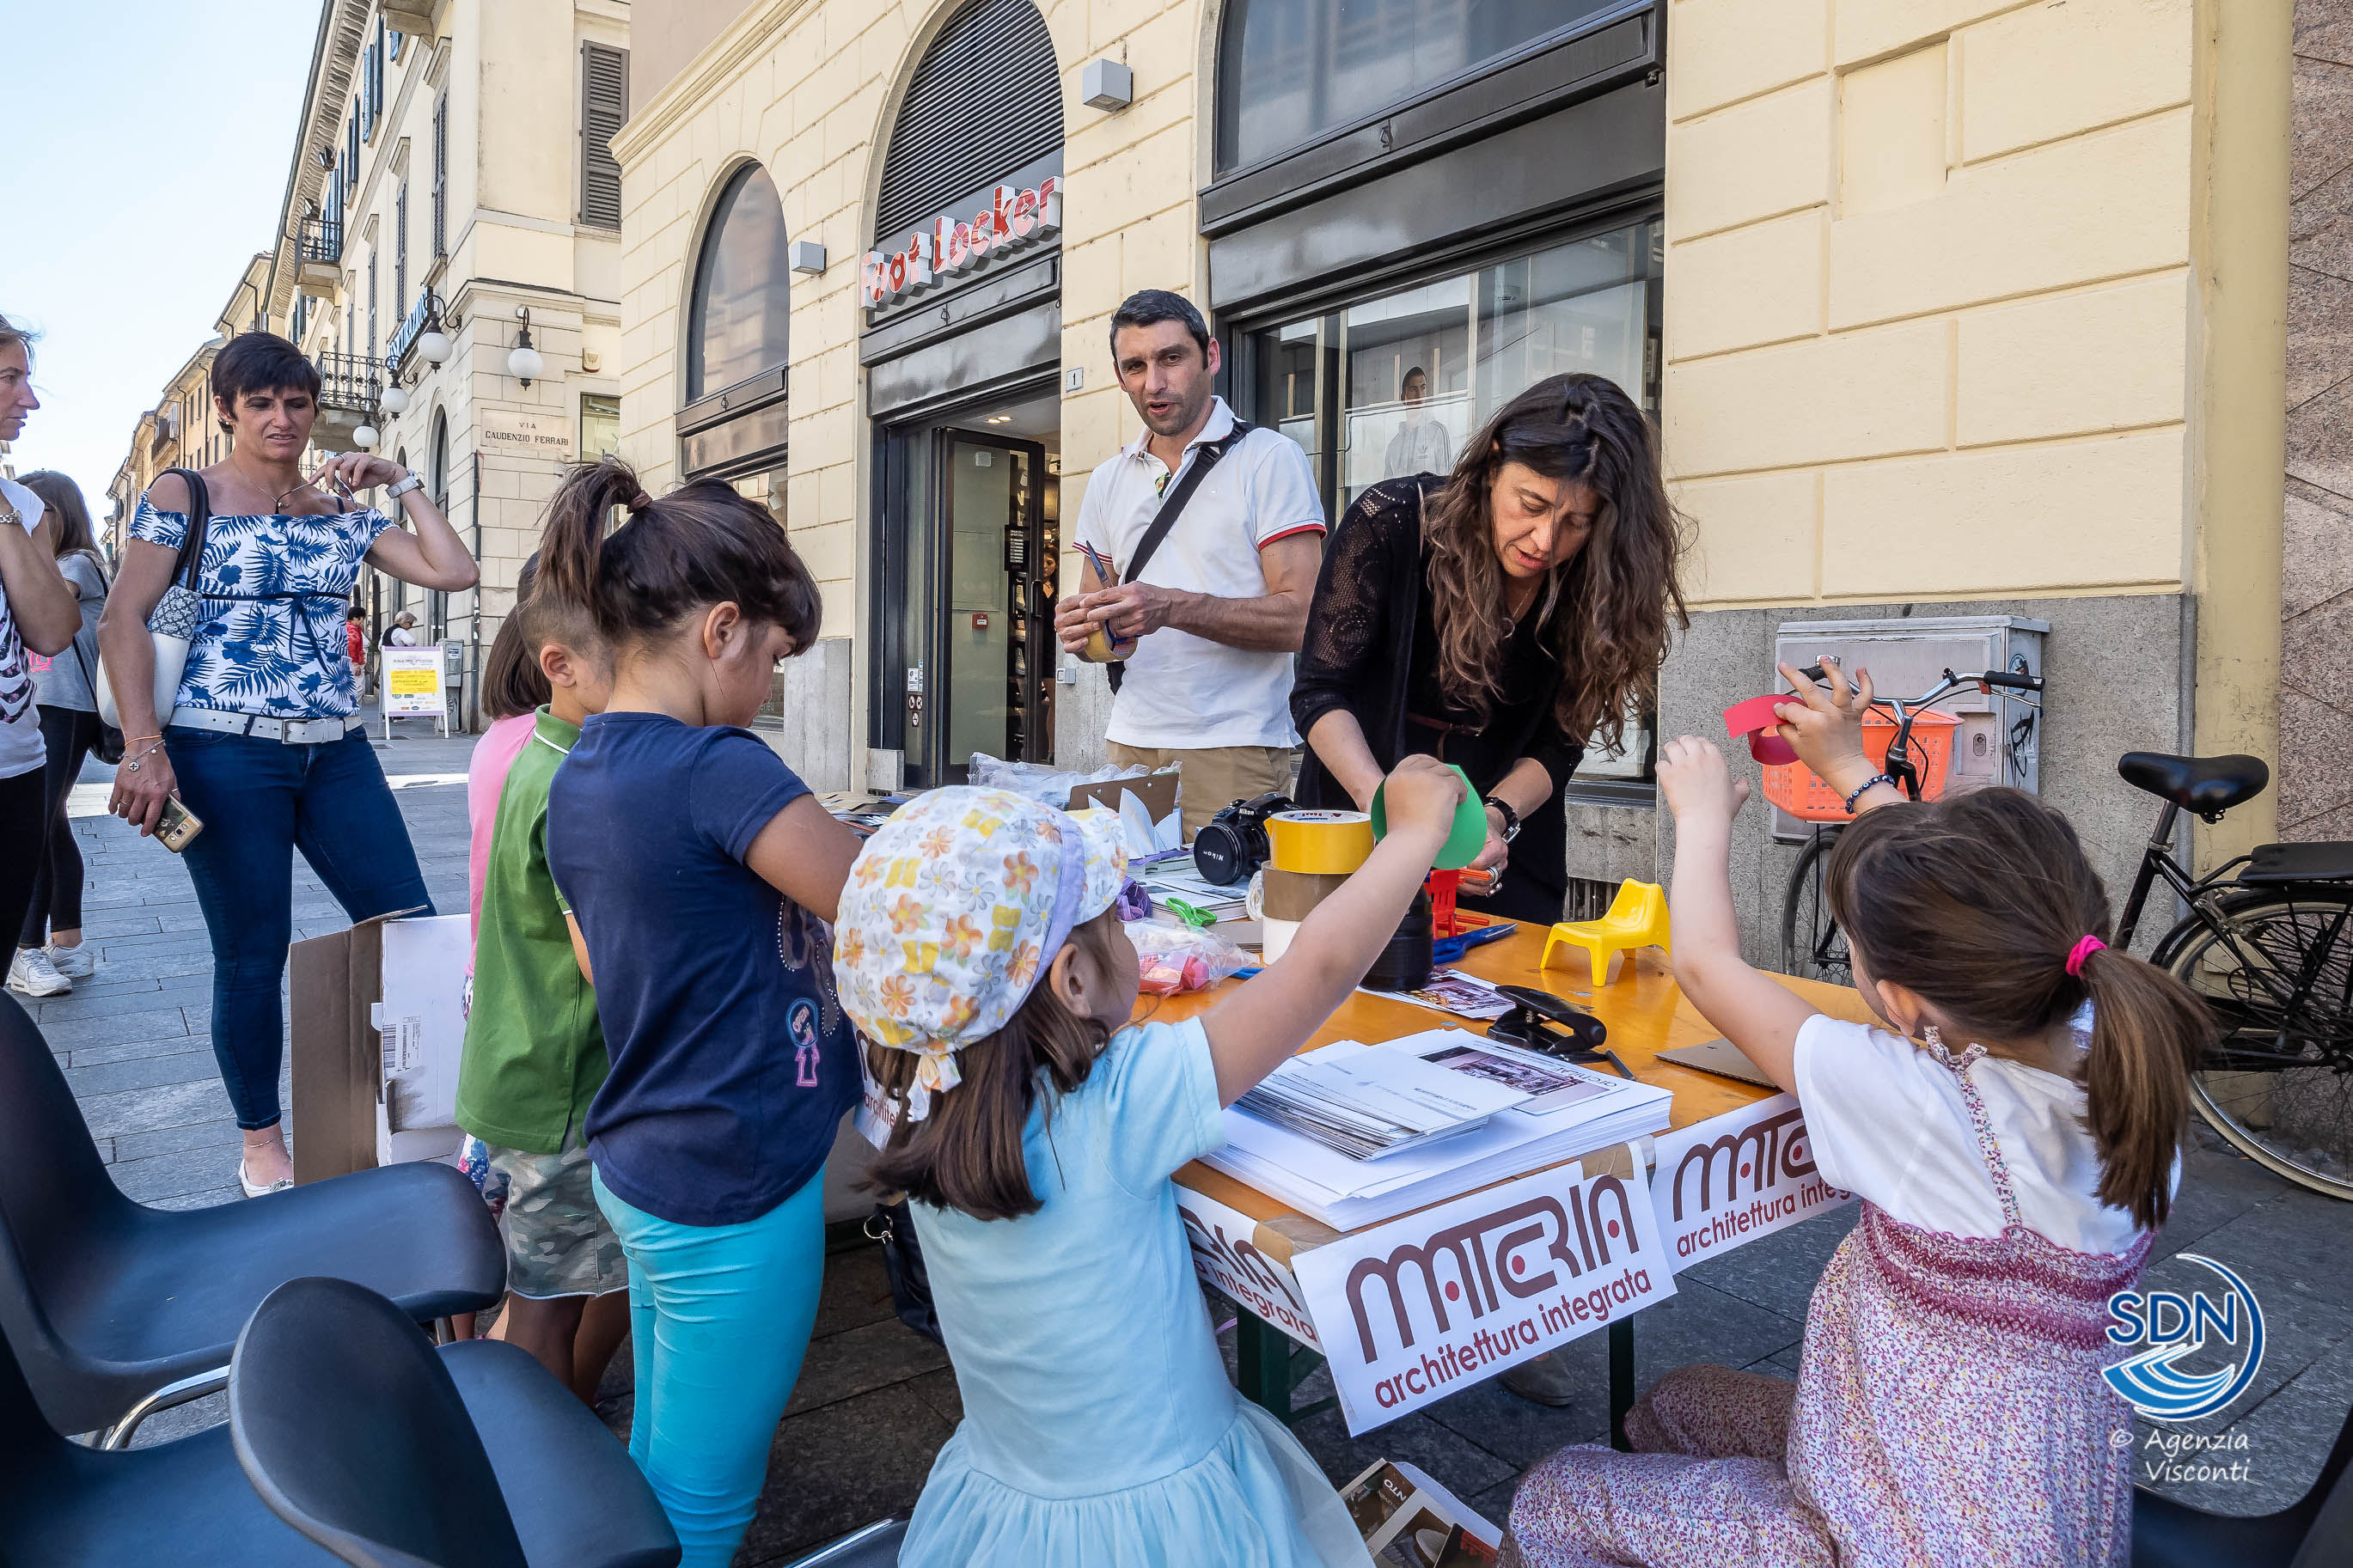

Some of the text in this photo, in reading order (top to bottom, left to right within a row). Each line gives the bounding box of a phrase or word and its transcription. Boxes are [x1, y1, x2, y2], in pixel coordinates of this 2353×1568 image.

[860, 232, 932, 309] Foot
[518, 421, 536, 430] VIA
[535, 436, 569, 446] FERRARI
[1238, 808, 1255, 816] Nikon
[1202, 850, 1225, 862] Nikon
[1677, 1194, 1796, 1258] architettura
[1208, 1261, 1318, 1343] integrata
[1375, 1268, 1653, 1409] architettura integrata
